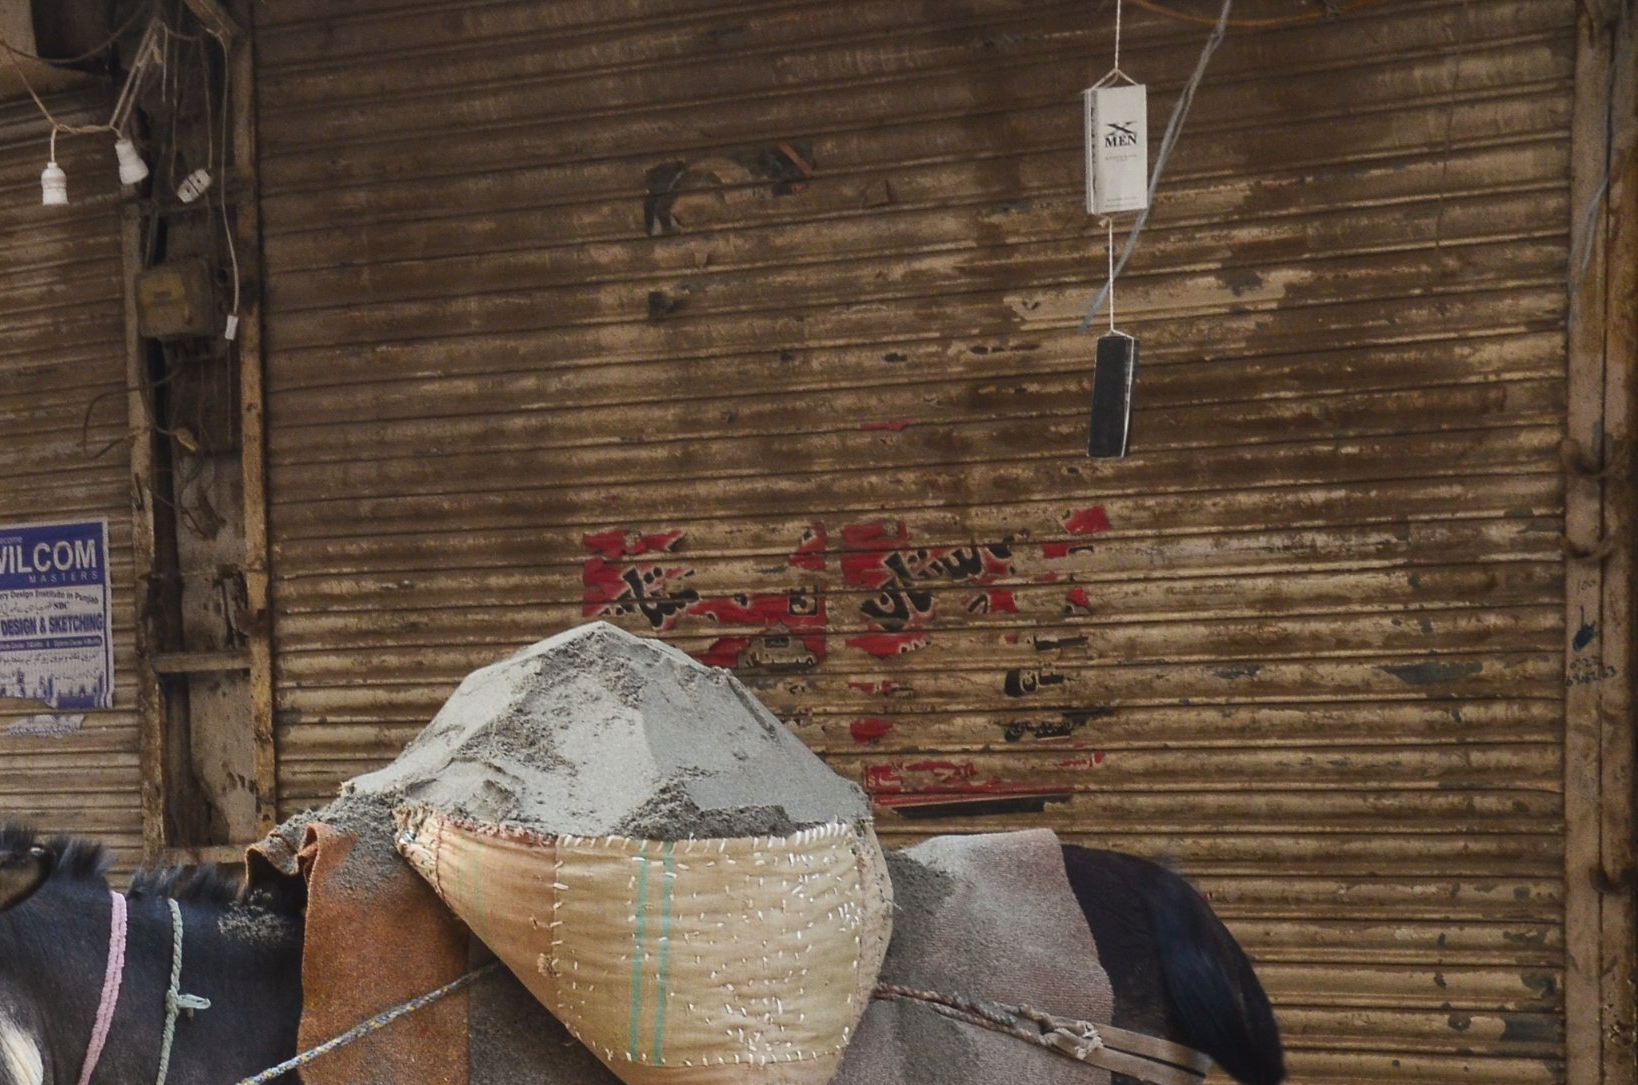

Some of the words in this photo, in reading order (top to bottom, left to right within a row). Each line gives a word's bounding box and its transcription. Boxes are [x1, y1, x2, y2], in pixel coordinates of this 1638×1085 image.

[1105, 134, 1137, 148] MEN
[29, 570, 99, 584] MASTERS
[11, 590, 34, 601] Design
[35, 590, 64, 600] Institute
[75, 591, 99, 605] Punjab
[0, 617, 37, 636] DESIGN
[39, 616, 47, 634] &
[48, 613, 103, 633] SKETCHING
